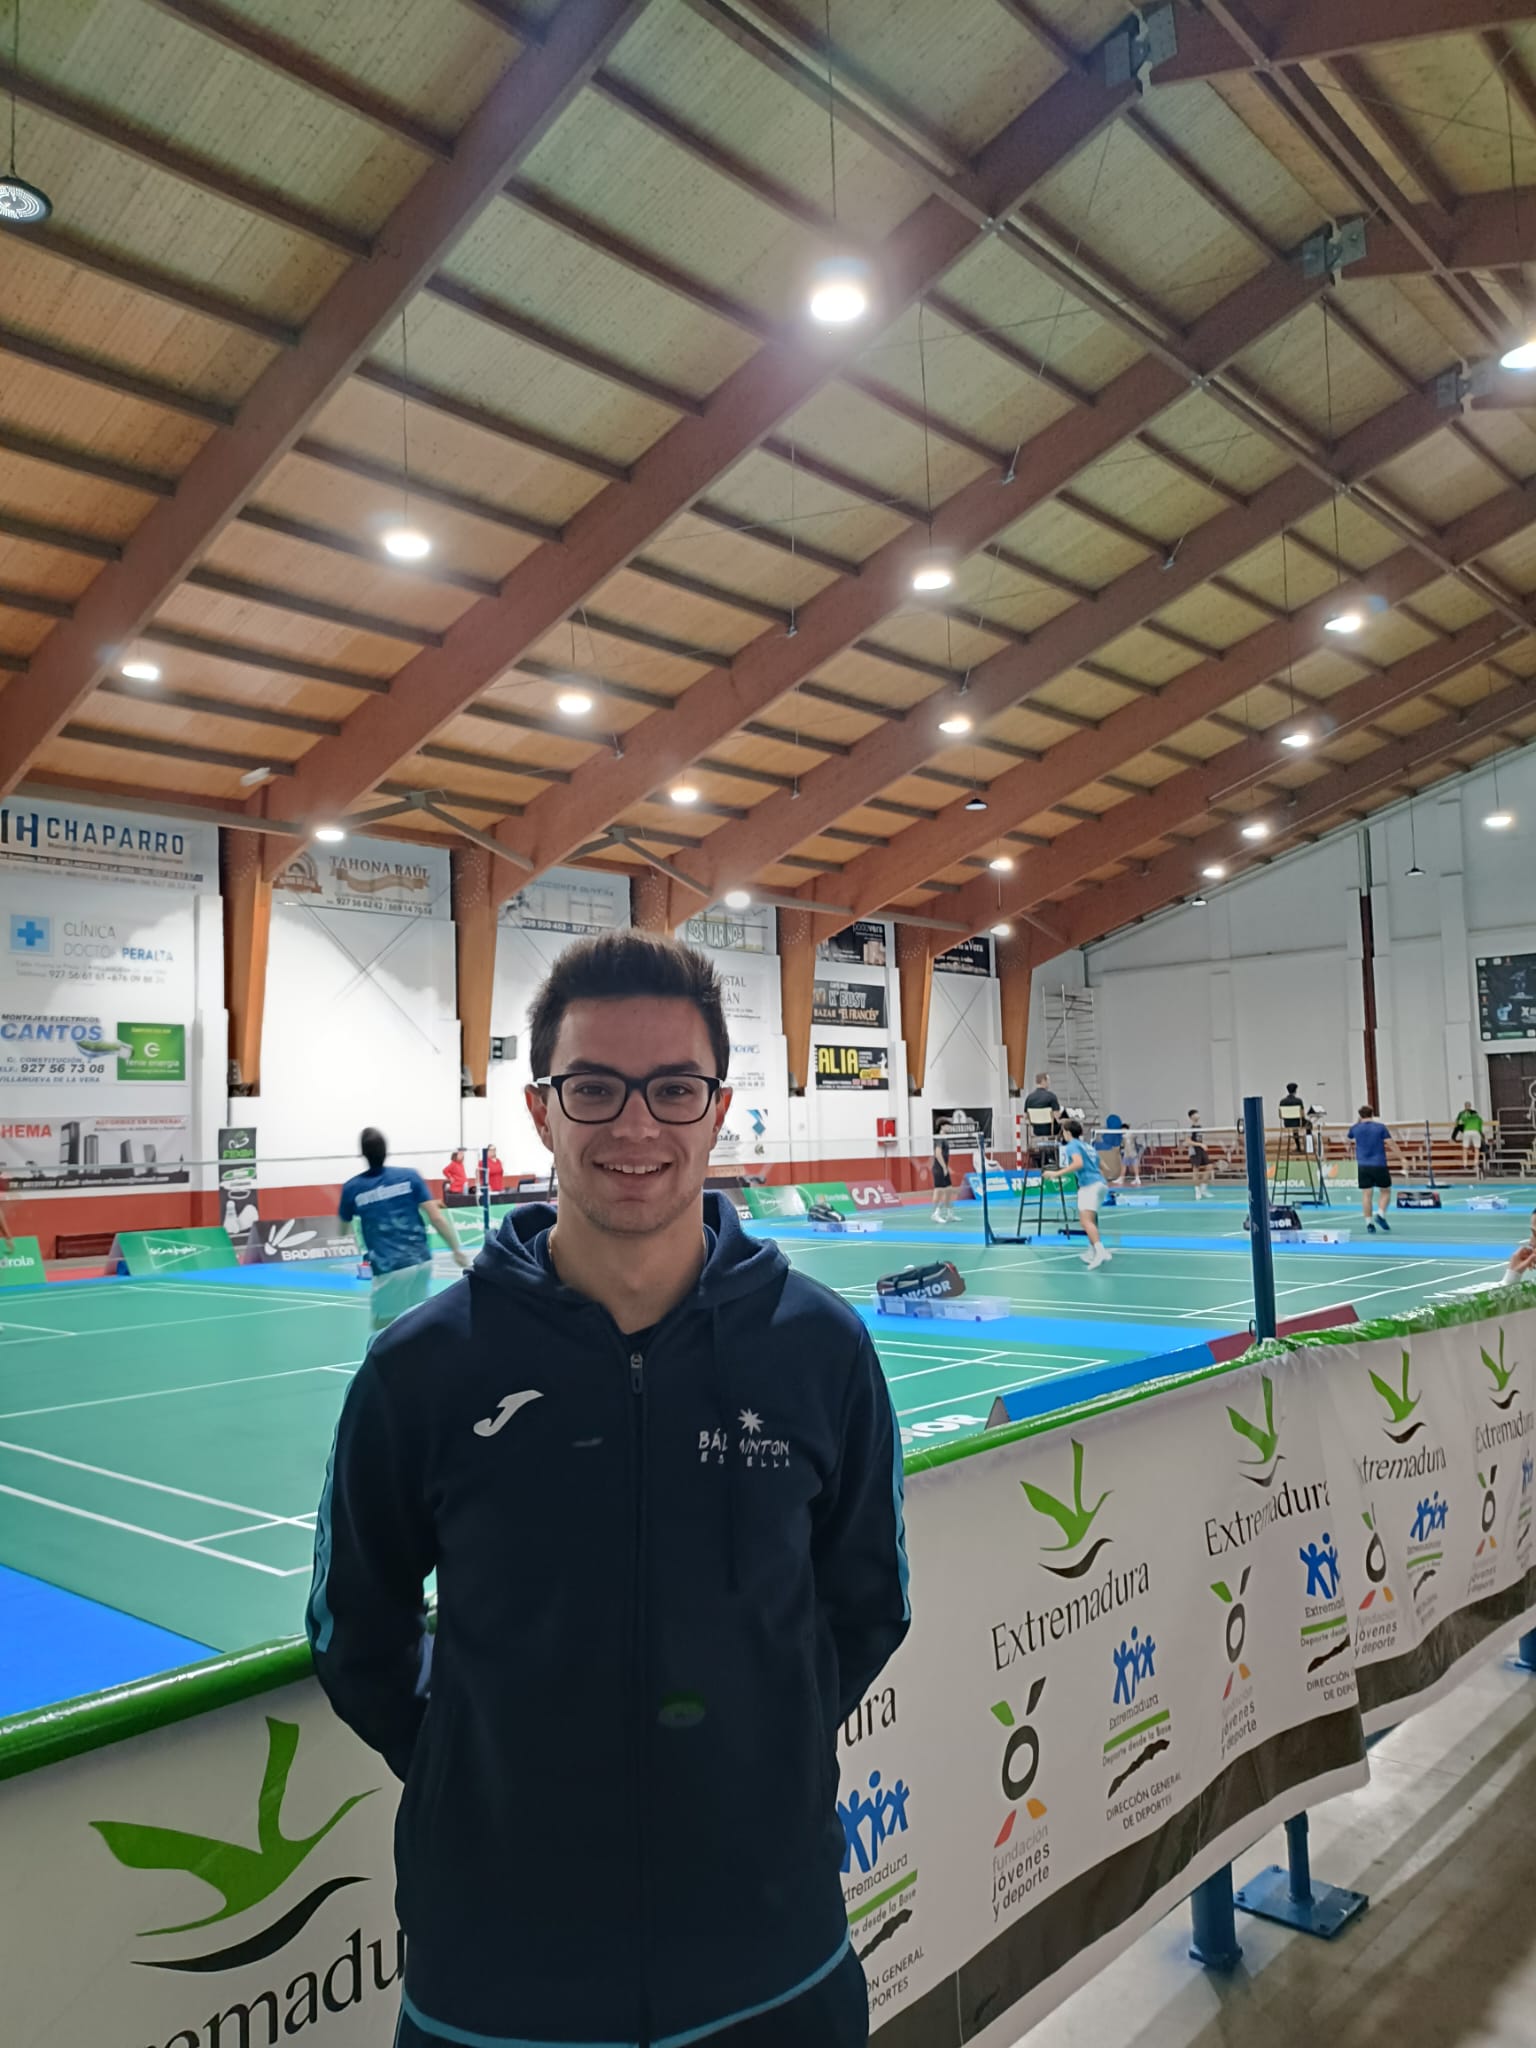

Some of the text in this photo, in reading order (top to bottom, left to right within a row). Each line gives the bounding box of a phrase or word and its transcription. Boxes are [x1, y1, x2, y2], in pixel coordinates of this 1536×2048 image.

[47, 817, 184, 855] CHAPARRO
[329, 855, 428, 879] TAHONA RAÚL
[64, 921, 116, 939] CLÍNICA
[122, 947, 174, 962] PERALTA
[1, 1023, 102, 1041] CANTOS
[2, 1014, 47, 1022] MONTAJES
[21, 1064, 45, 1073] 927
[49, 1064, 65, 1073] 56
[71, 1064, 85, 1073] 73
[89, 1064, 105, 1074] 08
[818, 1048, 859, 1074] ALIA
[990, 1561, 1150, 1672] Extremadura
[1108, 1693, 1159, 1732] Extremadura
[1106, 1771, 1182, 1822] DIRECCIÓN GENERAL
[1123, 1814, 1134, 1830] DE
[992, 1824, 1048, 1874] fundación
[992, 1842, 1050, 1903] jóvenes
[993, 1865, 1049, 1923] y deporte
[862, 1910, 887, 1933] desde
[889, 1901, 897, 1914] la
[882, 1945, 924, 1984] GENERAL
